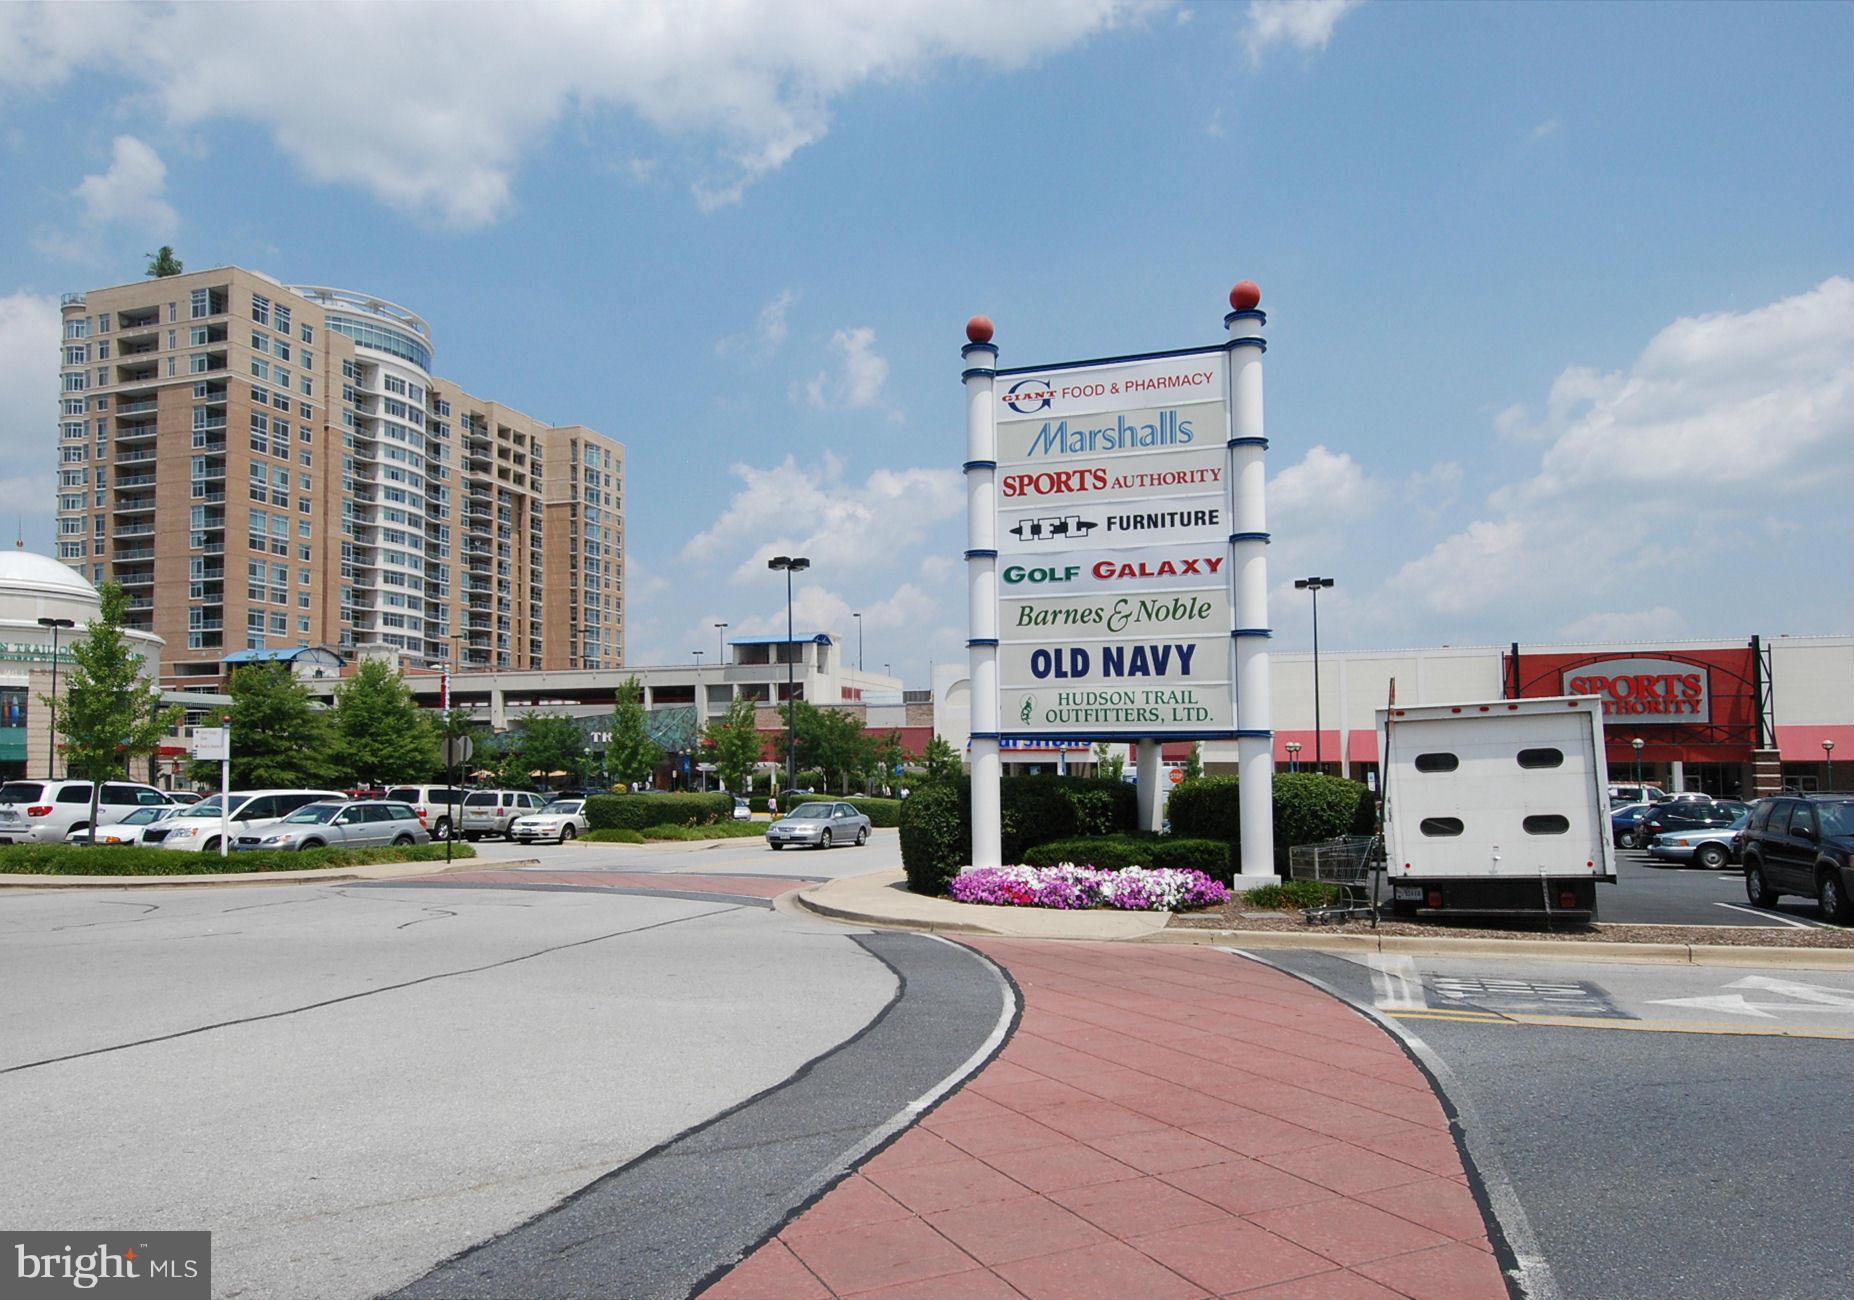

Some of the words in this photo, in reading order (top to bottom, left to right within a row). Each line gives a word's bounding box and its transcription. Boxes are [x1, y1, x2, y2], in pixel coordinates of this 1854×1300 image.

[1002, 390, 1057, 402] GIANT
[1062, 384, 1105, 399] FOOD
[1110, 381, 1120, 395] &
[1124, 372, 1214, 392] PHARMACY
[1027, 411, 1194, 457] Marshalls
[1002, 469, 1107, 497] SPORTS
[1111, 468, 1221, 489] AUTHORITY
[1106, 509, 1219, 532] FURNITURE
[1002, 565, 1081, 584] GOLF
[1092, 557, 1223, 579] GALAXY
[1016, 605, 1104, 627] Barnes
[1106, 598, 1133, 632] &
[1134, 597, 1212, 623] Noble
[1030, 648, 1090, 679] OLD
[1102, 643, 1197, 676] NAVY
[1058, 691, 1136, 706] HUDSON
[1142, 690, 1198, 705] TRAIL
[1571, 674, 1703, 699] SPORTS
[1045, 707, 1166, 724] OUTFITTERS,
[1172, 706, 1213, 722] LTD.
[1601, 699, 1702, 714] THORITY
